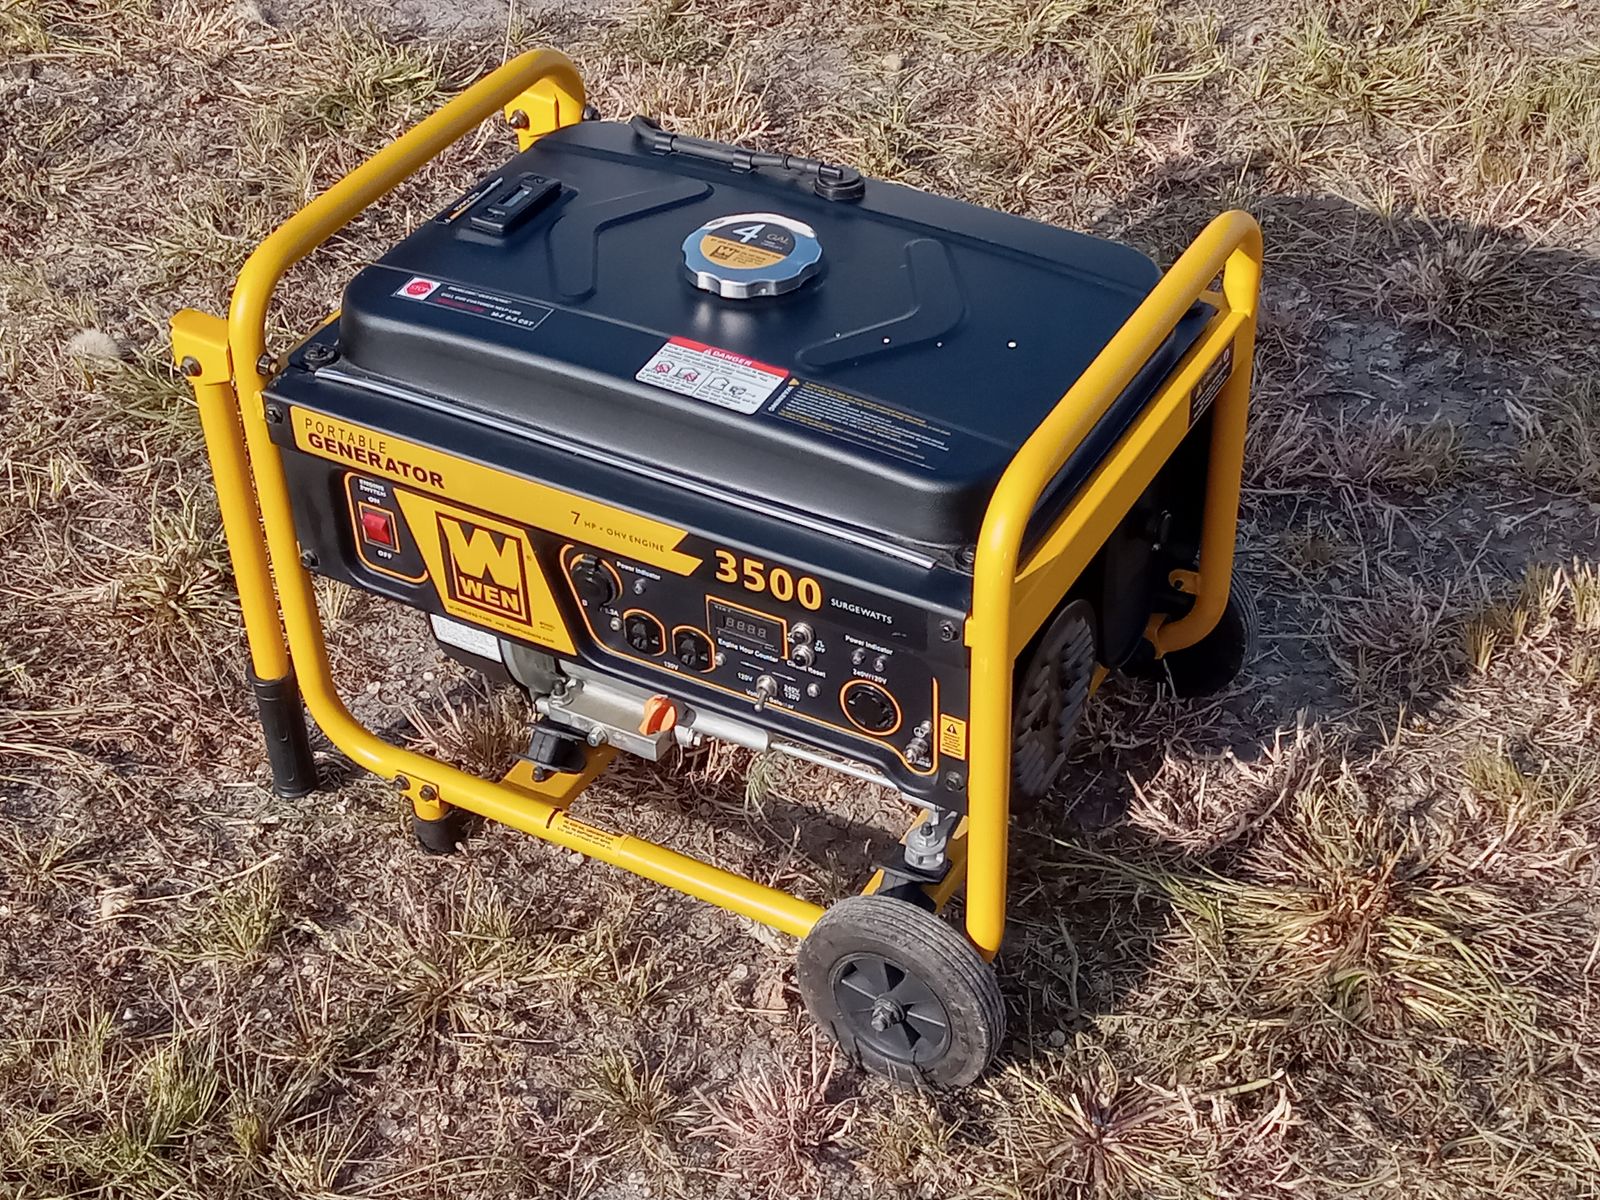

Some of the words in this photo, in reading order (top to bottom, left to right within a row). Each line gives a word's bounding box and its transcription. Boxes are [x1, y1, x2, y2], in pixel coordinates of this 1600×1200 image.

[733, 224, 766, 243] 4
[767, 234, 789, 245] GAL
[411, 284, 429, 293] STOP
[712, 351, 753, 367] DANGER
[305, 418, 387, 455] PORTABLE
[308, 433, 445, 489] GENERATOR
[367, 496, 381, 504] ON
[571, 511, 580, 525] 7
[584, 521, 597, 531] HP
[606, 528, 628, 540] OHV
[629, 535, 665, 553] ENGINE
[377, 550, 392, 560] OFF
[616, 561, 635, 572] Power
[635, 567, 661, 580] Indicator
[714, 550, 822, 611] 3500
[459, 576, 521, 613] WEN
[830, 598, 893, 625] SURGEWATTS
[717, 638, 739, 651] Engine
[739, 644, 754, 655] Hour
[754, 649, 779, 663] Counter
[844, 634, 865, 647] Power
[865, 641, 893, 655] Indicator
[663, 661, 679, 671] 120V
[808, 667, 826, 679] Reset
[737, 672, 753, 682] 120V
